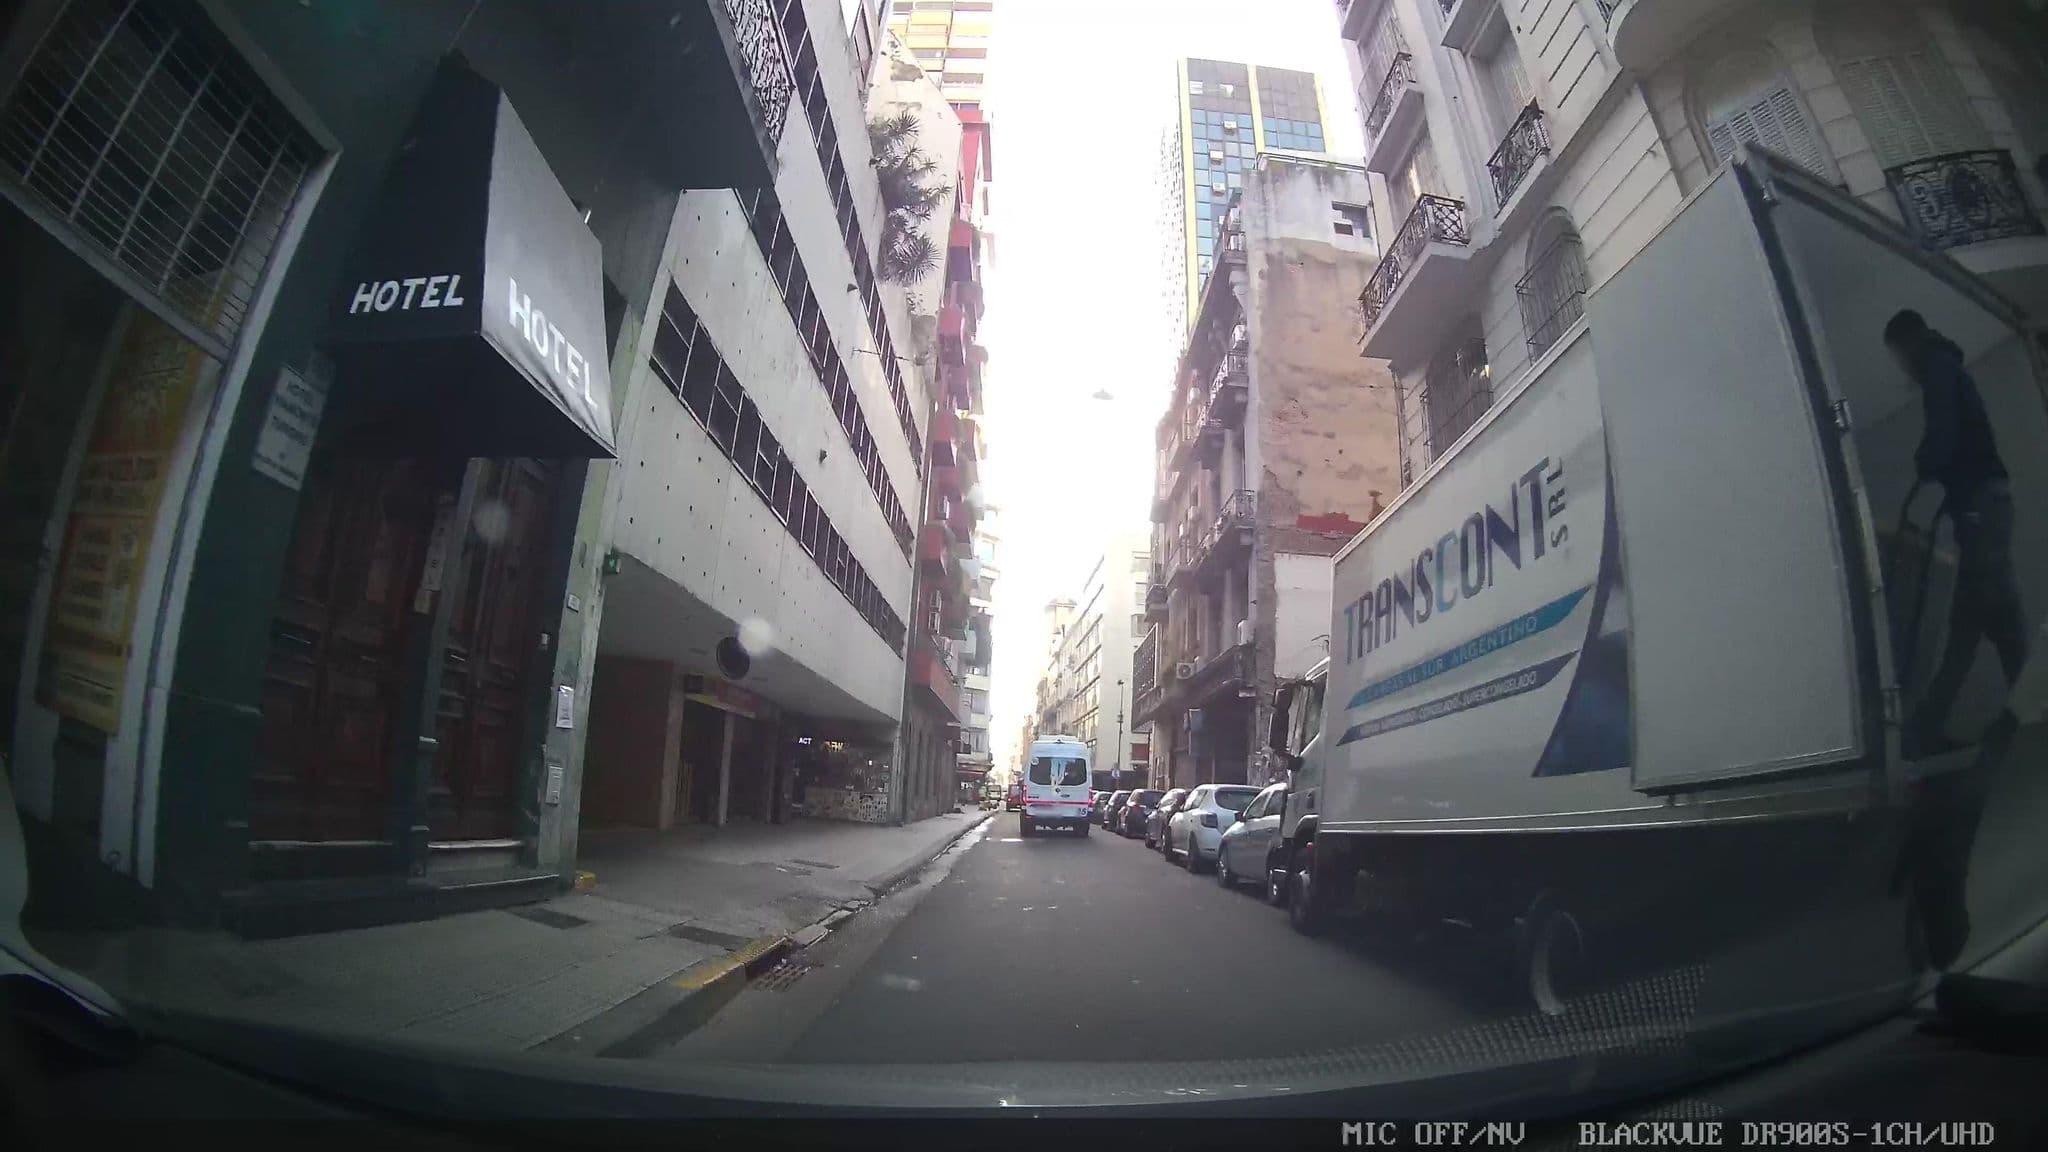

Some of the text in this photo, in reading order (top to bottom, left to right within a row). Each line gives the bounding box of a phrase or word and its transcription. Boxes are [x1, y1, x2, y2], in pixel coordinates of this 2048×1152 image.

[350, 274, 465, 314] HOTEL
[508, 277, 597, 411] HOTEL
[1343, 456, 1549, 665] TRANSCONT
